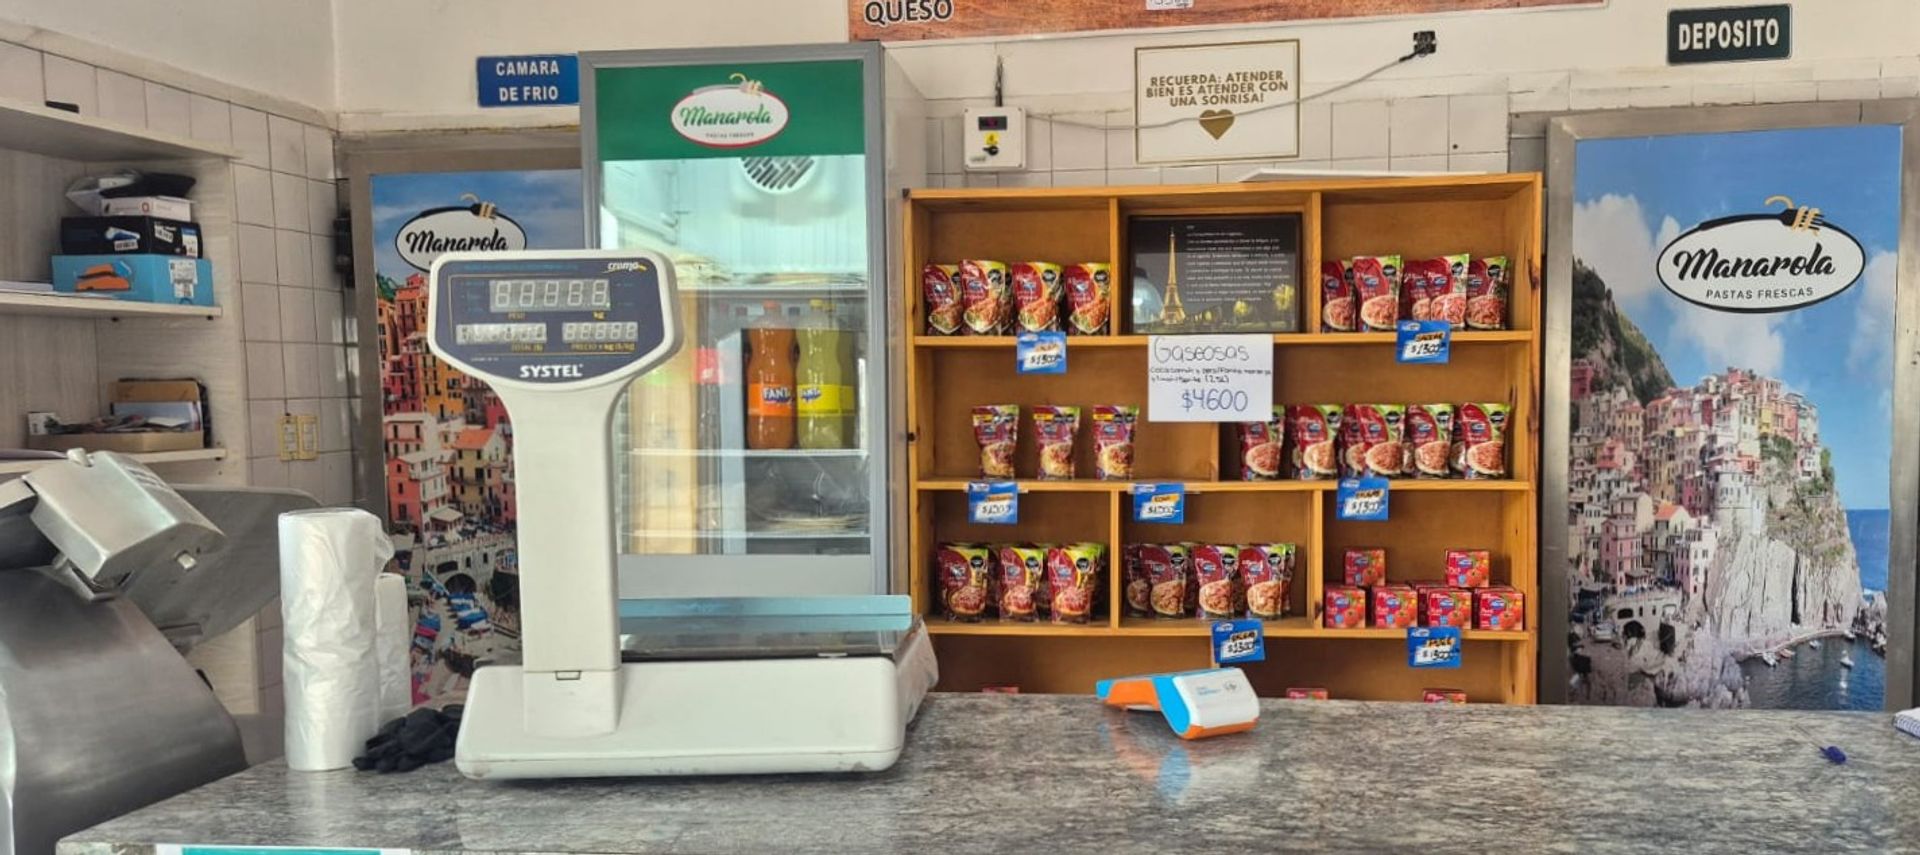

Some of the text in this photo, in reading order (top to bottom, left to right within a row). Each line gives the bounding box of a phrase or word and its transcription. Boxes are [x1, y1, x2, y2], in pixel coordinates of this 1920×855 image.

[865, 0, 953, 25] QUESO
[1678, 18, 1780, 50] DEPOSITO
[496, 60, 560, 76] CAMARA
[1150, 70, 1284, 87] RECUERDA: ATENDER
[499, 85, 559, 102] DE FRIO
[1146, 81, 1289, 98] BIEN ES ATENDER CON
[1169, 93, 1265, 107] UNA SONRISA!
[679, 103, 773, 127] Manarola
[405, 227, 509, 253] Manarola
[1673, 242, 1836, 280] Manarola
[1706, 286, 1814, 300] PASTAS FRESCAS
[1153, 335, 1250, 363] Gaseosas
[519, 364, 583, 378] SYSTEL
[1182, 388, 1249, 413] $4600
